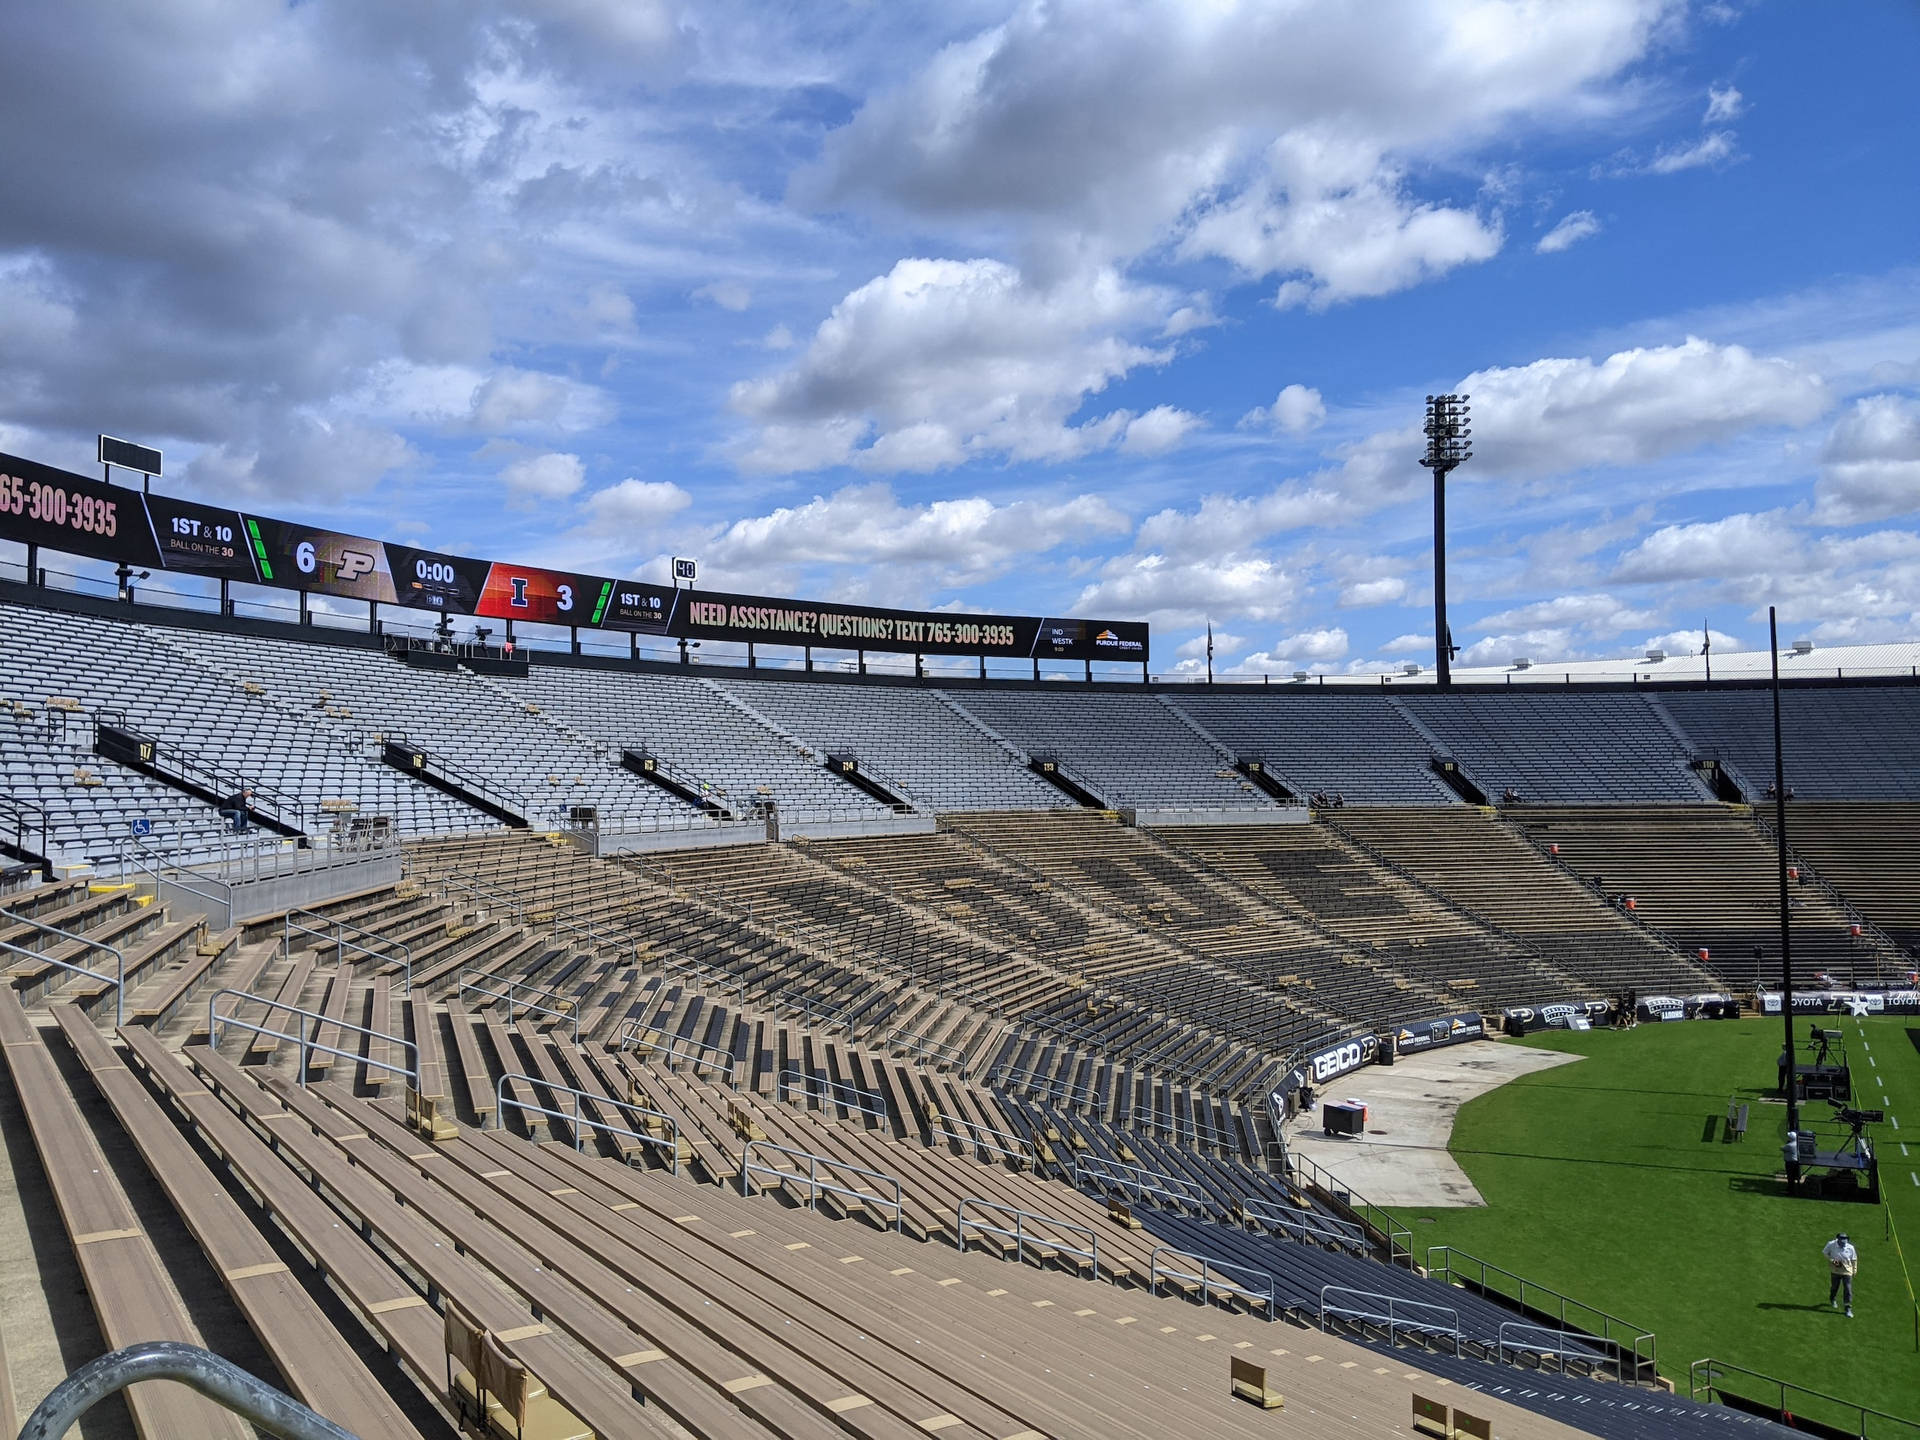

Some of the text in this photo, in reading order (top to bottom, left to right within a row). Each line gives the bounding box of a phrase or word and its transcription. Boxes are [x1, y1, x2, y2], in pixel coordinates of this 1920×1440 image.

[171, 517, 233, 542] 1ST & 10
[170, 538, 234, 558] BALL ON THE 30
[296, 541, 316, 573] 6
[416, 559, 455, 583] 0:00
[678, 561, 694, 577] 40
[556, 584, 573, 611] 3
[620, 593, 661, 609] 1ST & 10
[619, 608, 633, 616] BALL
[642, 611, 652, 619] THE
[653, 611, 662, 620] 30
[690, 601, 1014, 646] NEED ASSISTANCE? QUESTIONS? TEXT 765-300-3935
[1051, 628, 1064, 636] IND
[1703, 760, 1715, 769] 110
[1791, 998, 1823, 1006] OYOTA
[1465, 1024, 1481, 1032] FEDERAL
[1414, 1035, 1431, 1043] FEDERAL
[1314, 1043, 1361, 1080] GEICO
